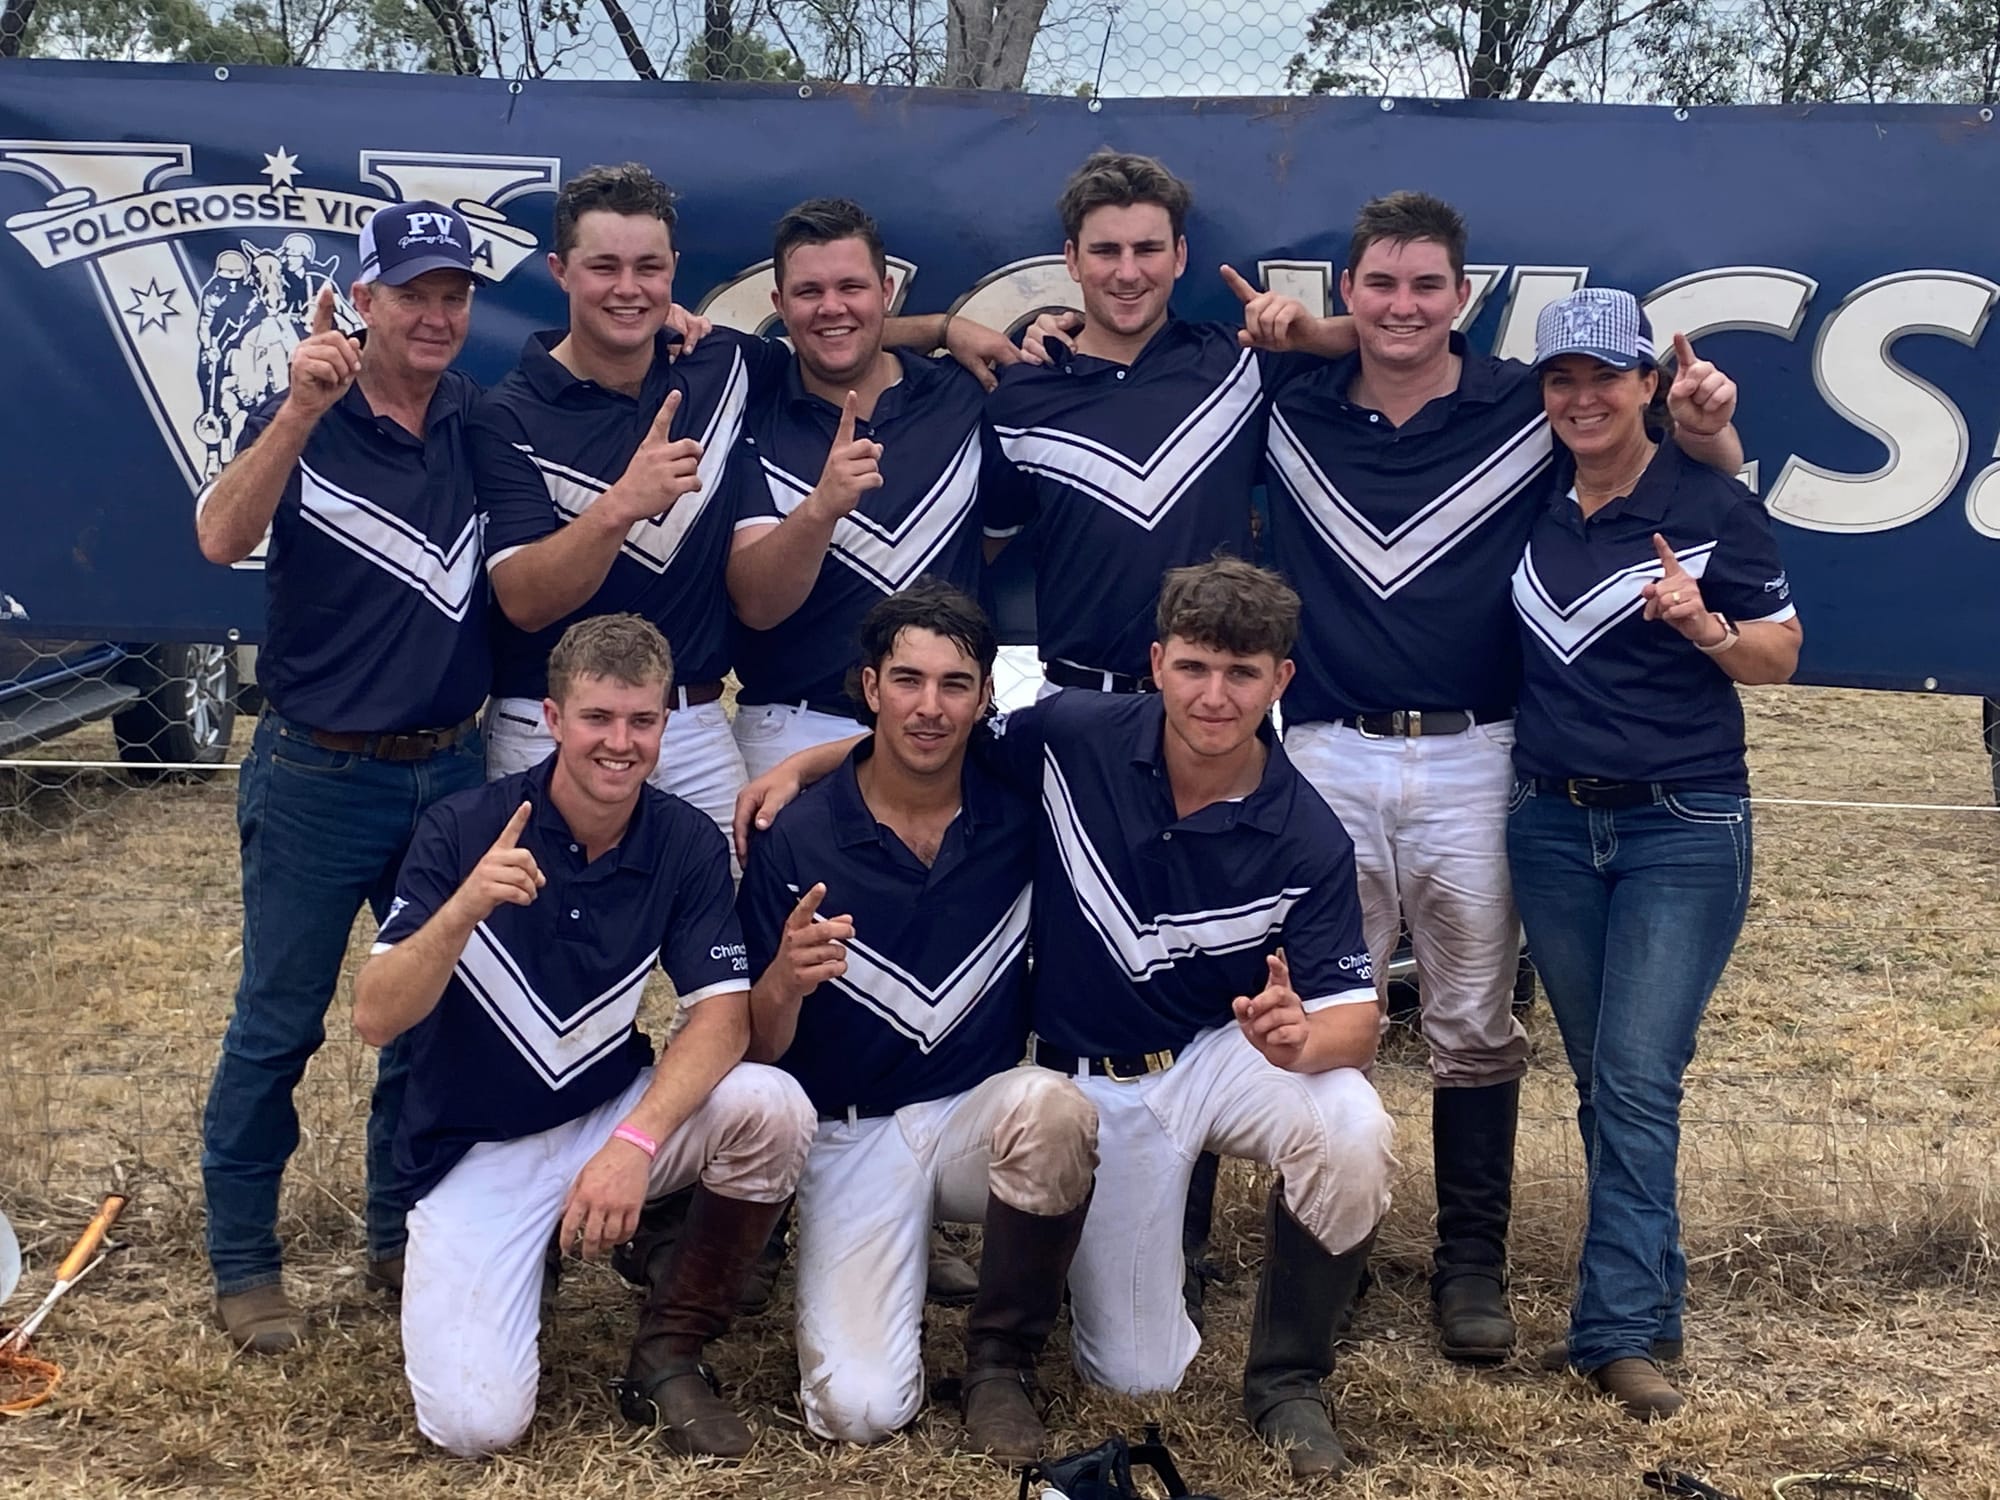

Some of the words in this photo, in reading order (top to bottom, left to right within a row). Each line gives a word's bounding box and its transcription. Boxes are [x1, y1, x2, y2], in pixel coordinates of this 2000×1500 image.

[45, 193, 305, 255] POLOCROSSE
[316, 198, 495, 270] VICA
[406, 212, 453, 236] PV
